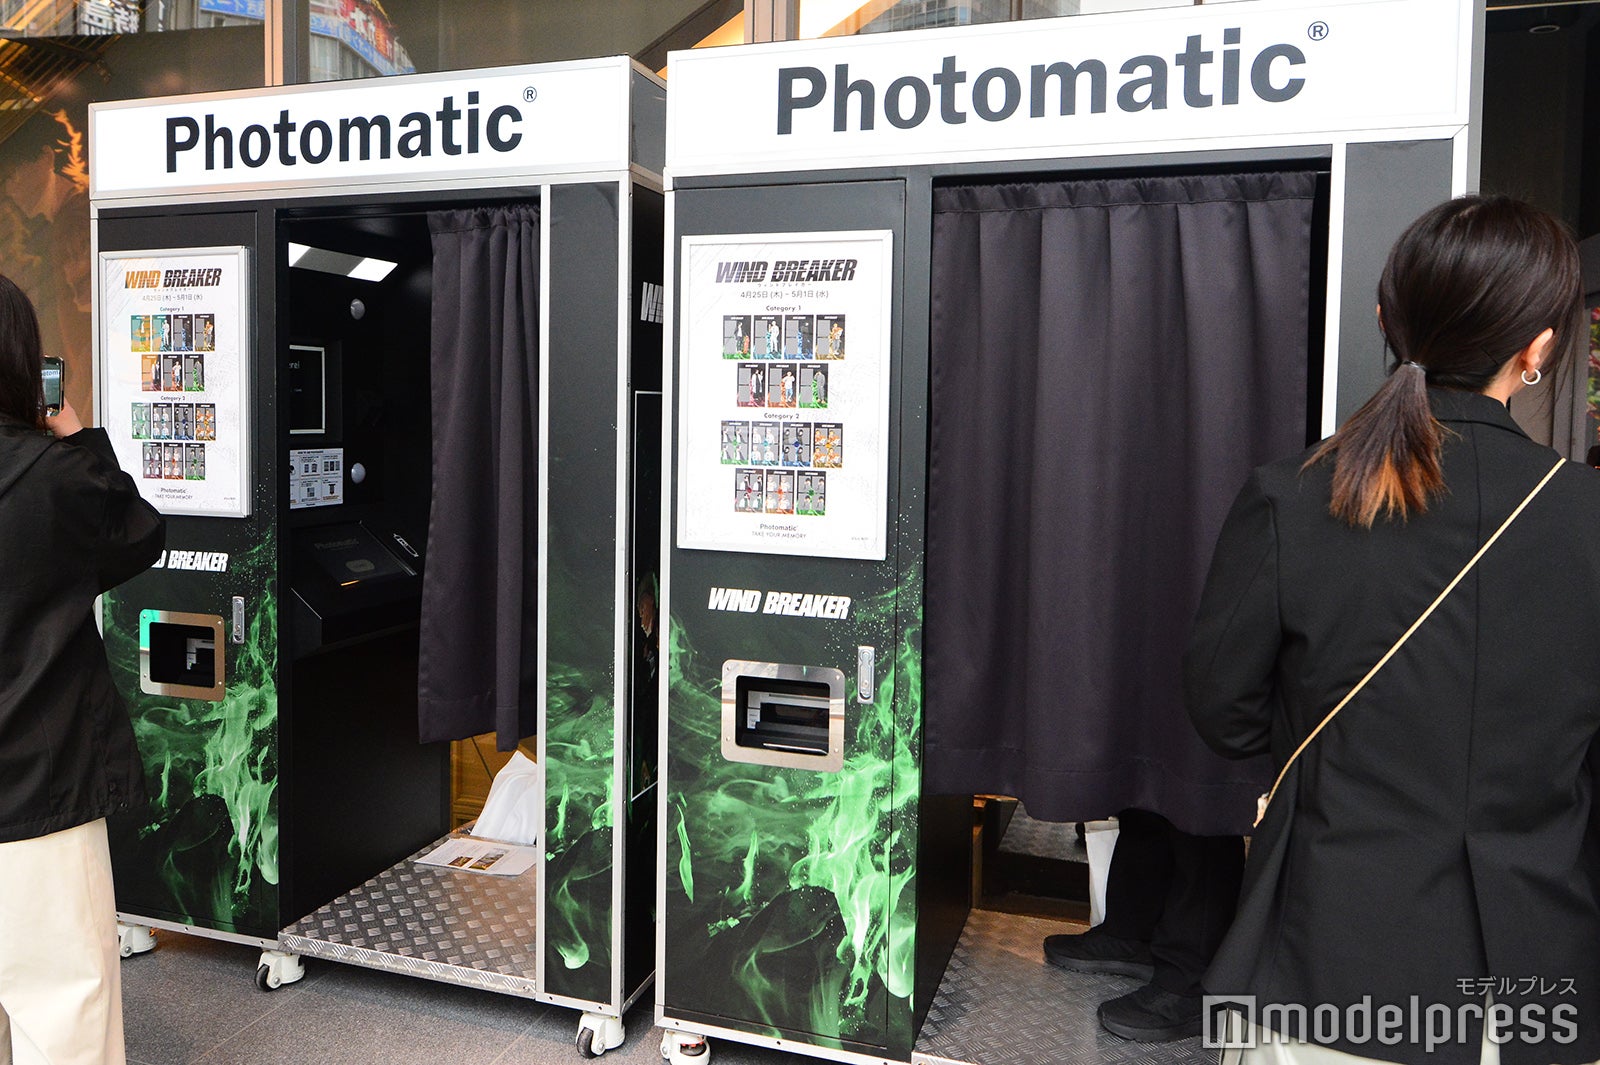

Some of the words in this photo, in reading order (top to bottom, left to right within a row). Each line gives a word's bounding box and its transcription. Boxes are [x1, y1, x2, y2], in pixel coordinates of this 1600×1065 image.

[124, 270, 161, 289] WIND
[163, 267, 222, 288] BREAKER
[715, 261, 769, 284] WIND
[770, 259, 858, 283] BREAKER
[764, 412, 793, 420] Category
[167, 550, 229, 572] BREAKER
[708, 587, 762, 613] WIND
[762, 591, 851, 620] BREAKER
